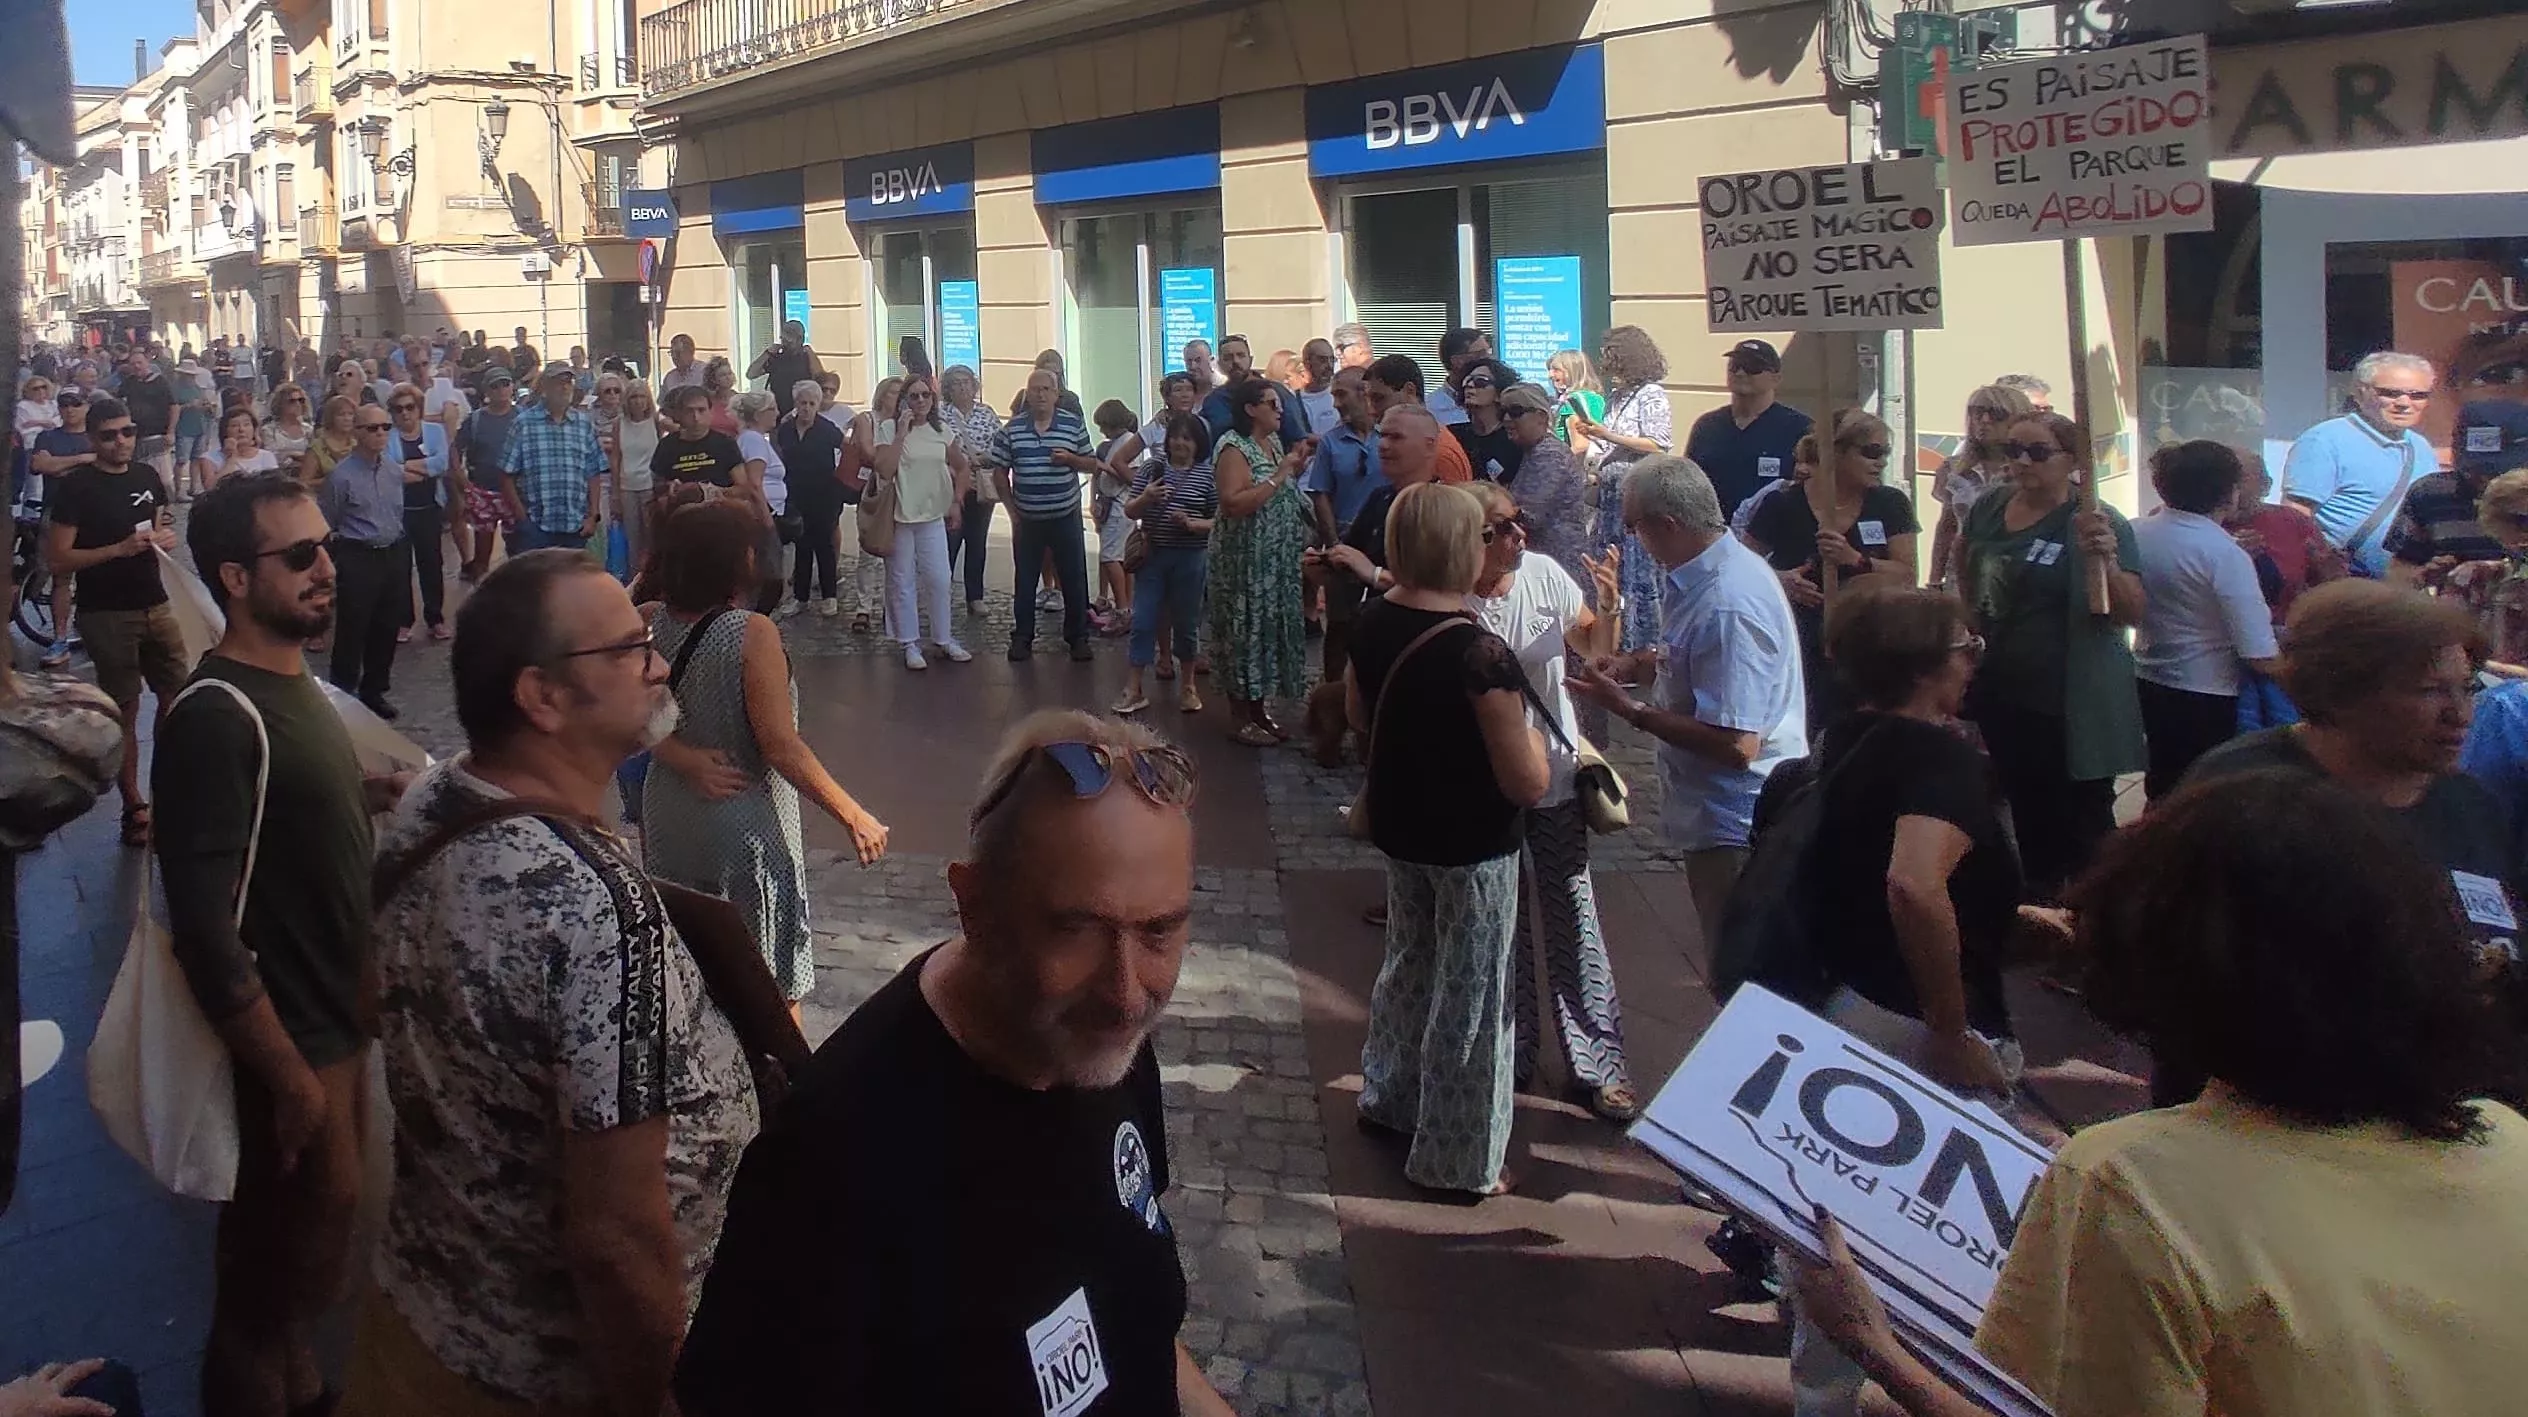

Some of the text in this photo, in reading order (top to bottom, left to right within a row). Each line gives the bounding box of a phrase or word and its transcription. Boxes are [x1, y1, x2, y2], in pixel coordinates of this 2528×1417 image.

[1365, 76, 1525, 150] BBVA
[1958, 78, 2010, 114] ES
[2207, 45, 2528, 152] ARM
[870, 161, 942, 206] BBVA
[1994, 143, 2187, 185] EL PARQUE
[631, 207, 669, 221] BBVA
[1700, 164, 1903, 219] OROEL
[1961, 200, 2032, 223] QUEDA
[1743, 251, 1798, 281] NO
[1710, 286, 1809, 323] PARQUE
[624, 933, 641, 1045] LOYALTY
[1774, 1120, 2007, 1274] ROEL PARK
[1038, 1323, 1099, 1411] ¡NO!
